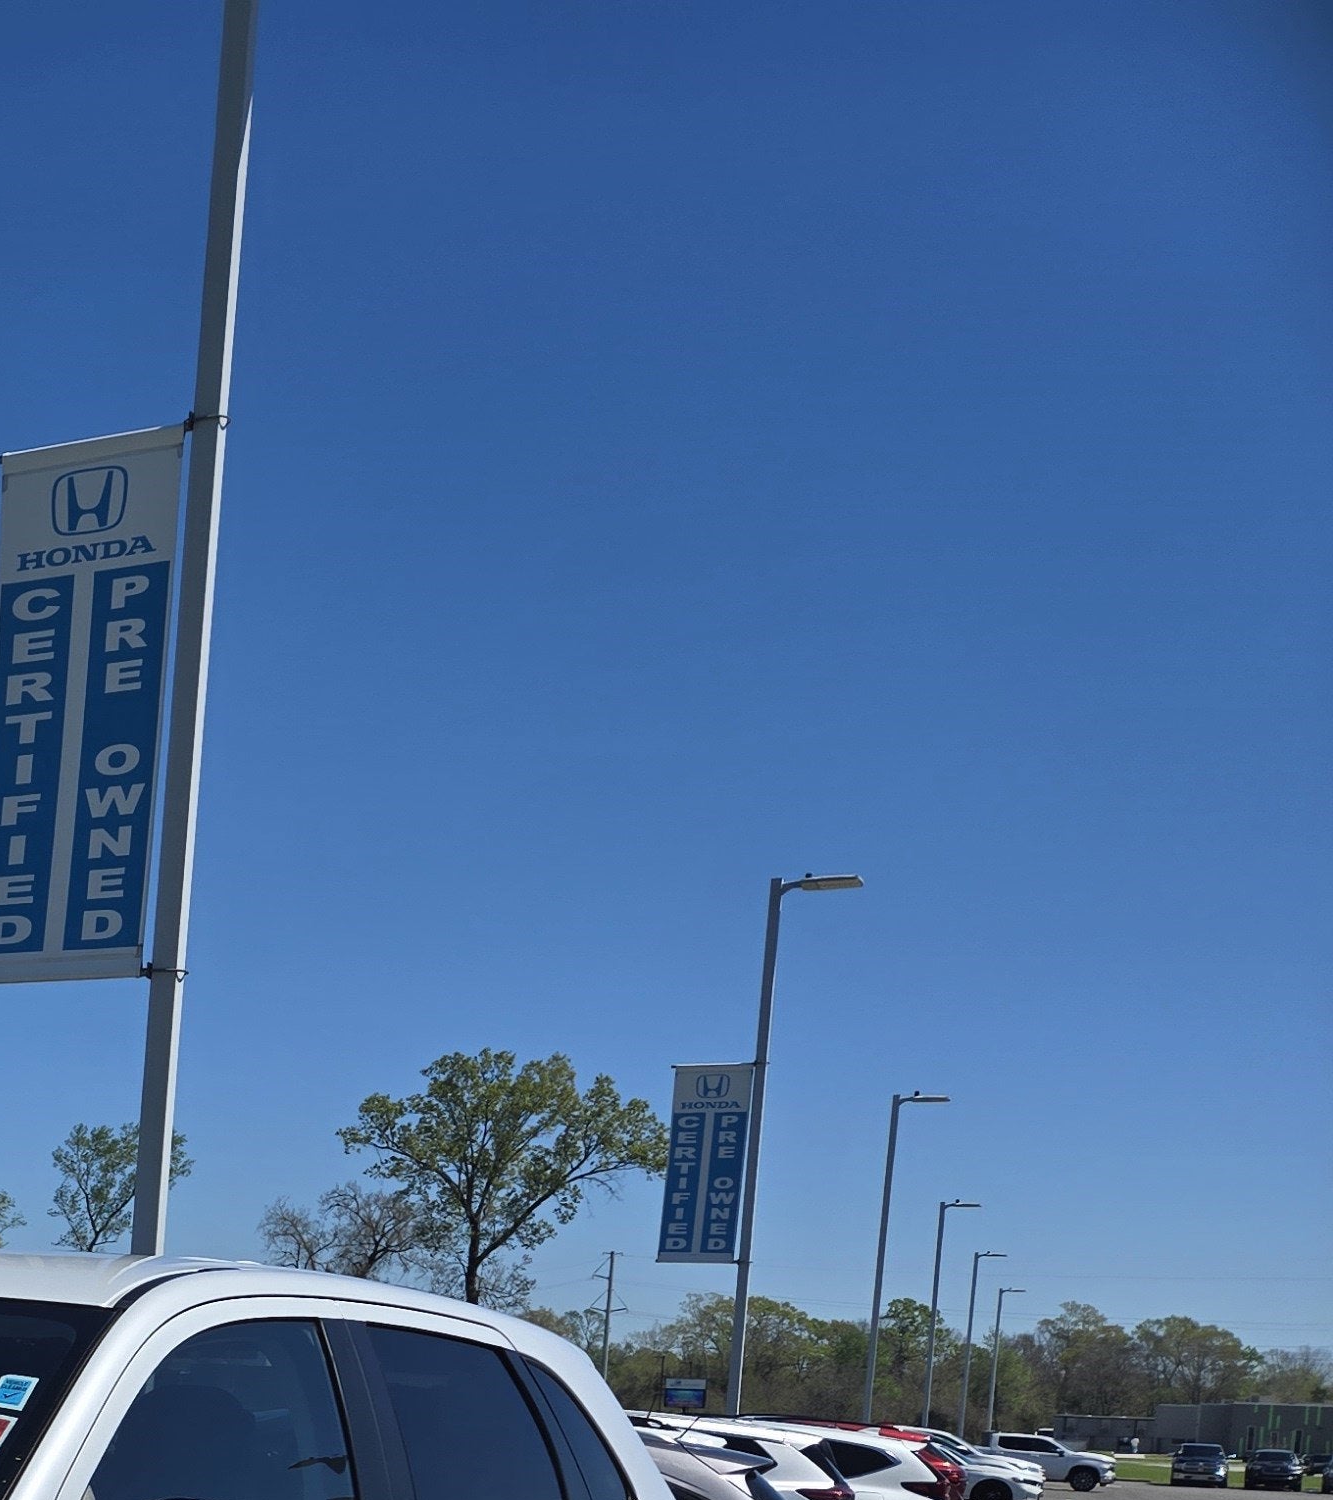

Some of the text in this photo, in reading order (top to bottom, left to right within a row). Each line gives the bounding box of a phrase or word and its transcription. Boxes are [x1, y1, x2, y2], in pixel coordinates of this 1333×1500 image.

[16, 535, 157, 572] HONDA
[81, 574, 151, 941] PRE OWNED
[680, 1100, 741, 1110] HONDA
[665, 1115, 701, 1251] CERTIFIED
[707, 1115, 739, 1251] PRE OWNED
